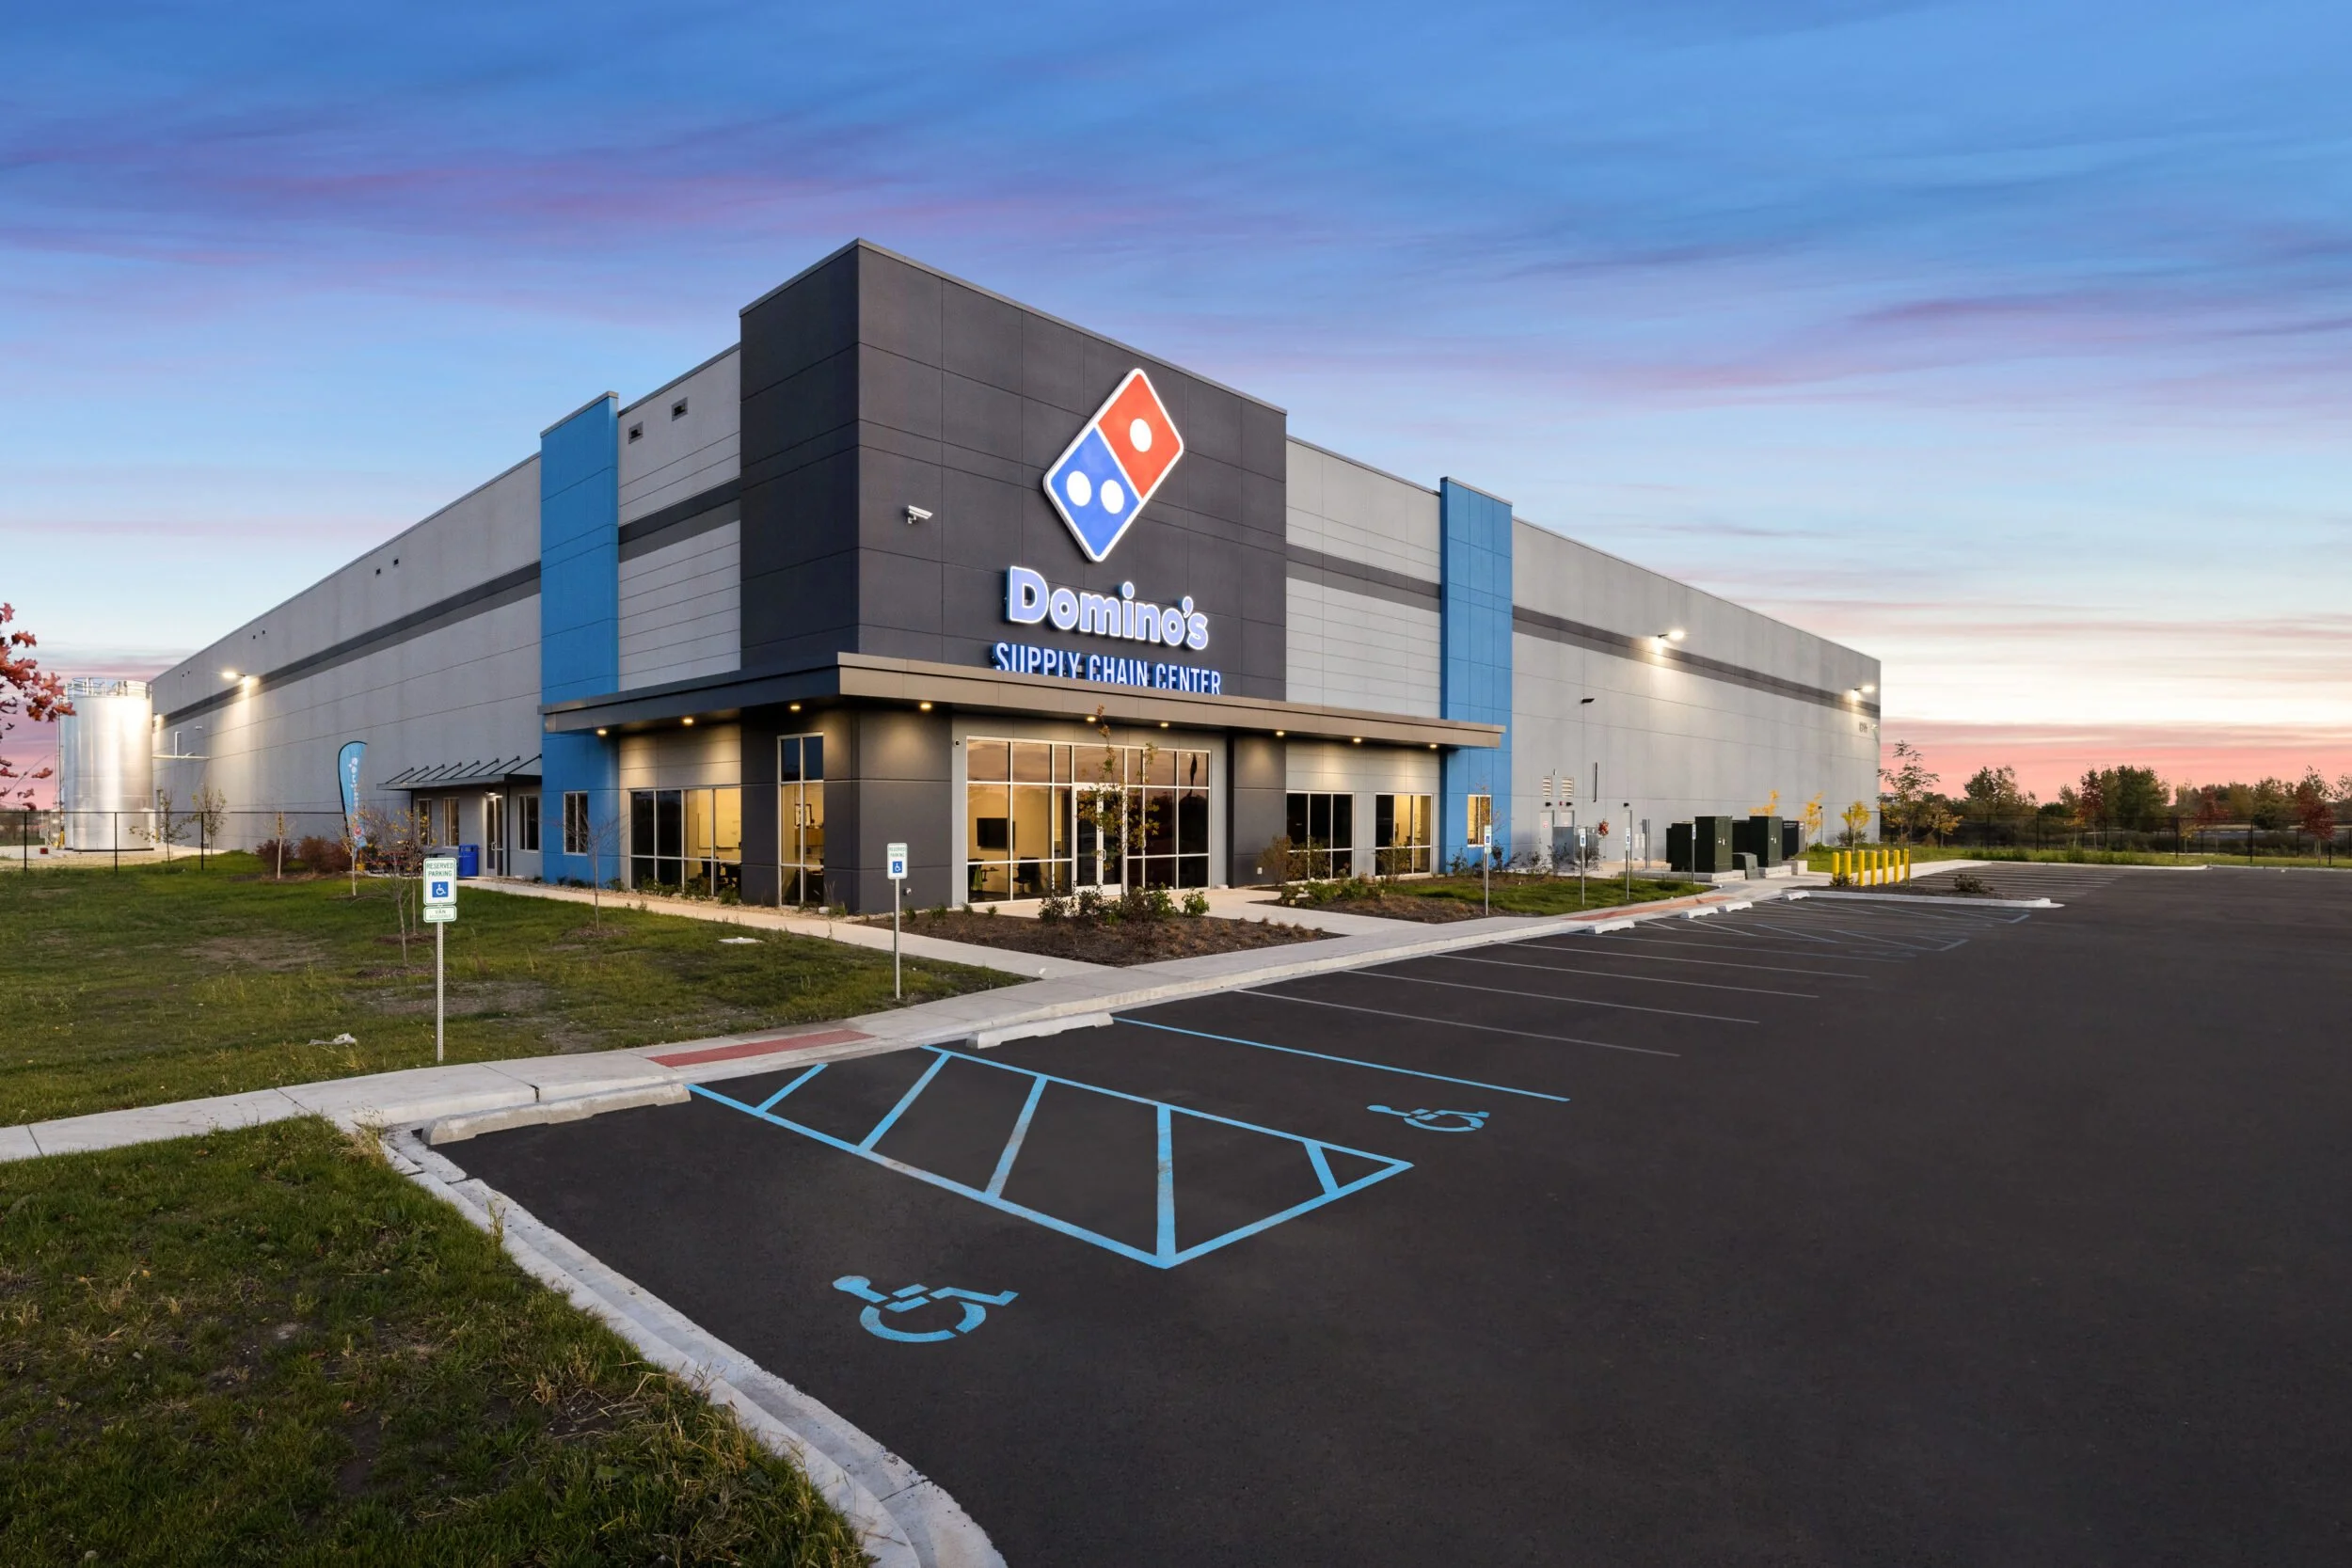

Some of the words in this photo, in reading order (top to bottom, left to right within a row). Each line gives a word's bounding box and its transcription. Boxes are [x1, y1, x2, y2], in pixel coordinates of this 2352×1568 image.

[1009, 565, 1209, 651] Domino's
[995, 641, 1081, 679] SUPPLY
[1089, 654, 1148, 688] CHAIN
[1155, 662, 1221, 695] CENTER
